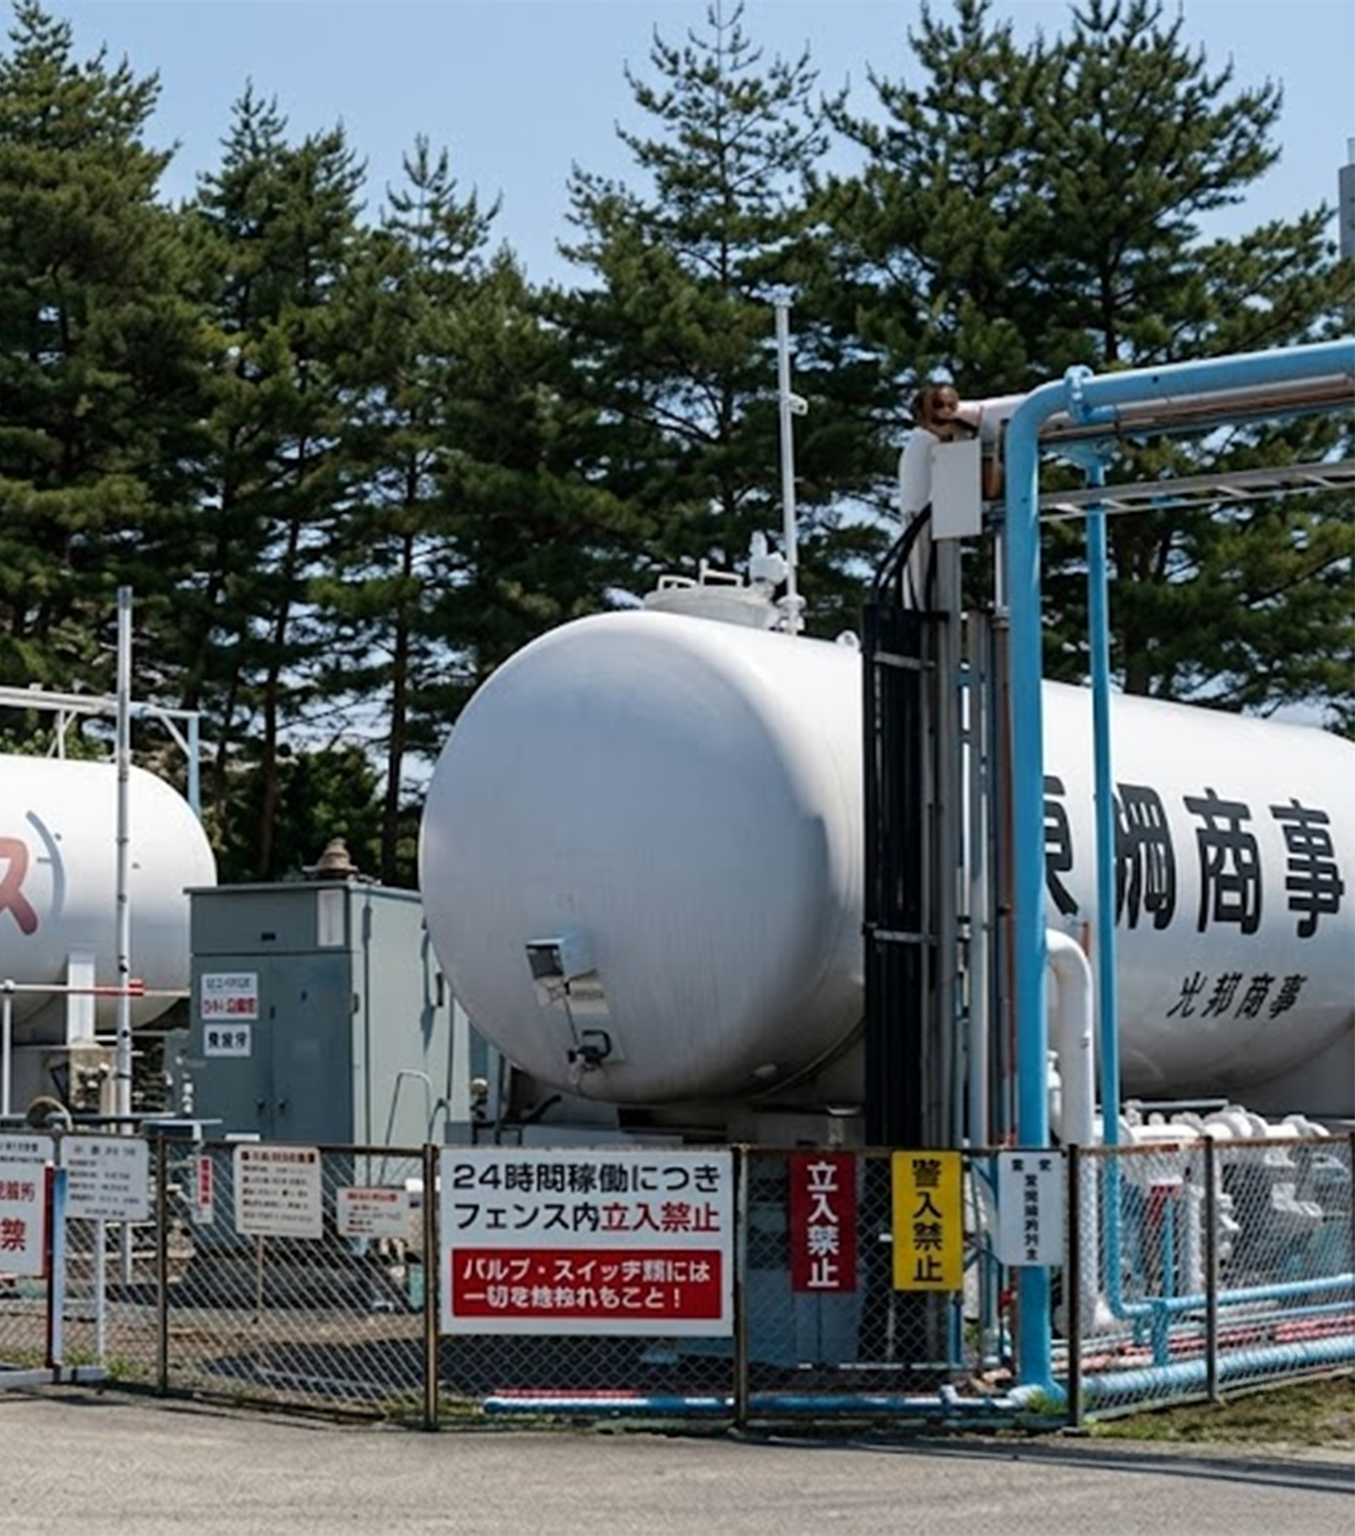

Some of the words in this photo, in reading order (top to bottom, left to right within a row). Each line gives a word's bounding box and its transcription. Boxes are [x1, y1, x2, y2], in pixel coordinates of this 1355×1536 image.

[454, 1203, 721, 1232] フェンス内立入禁止
